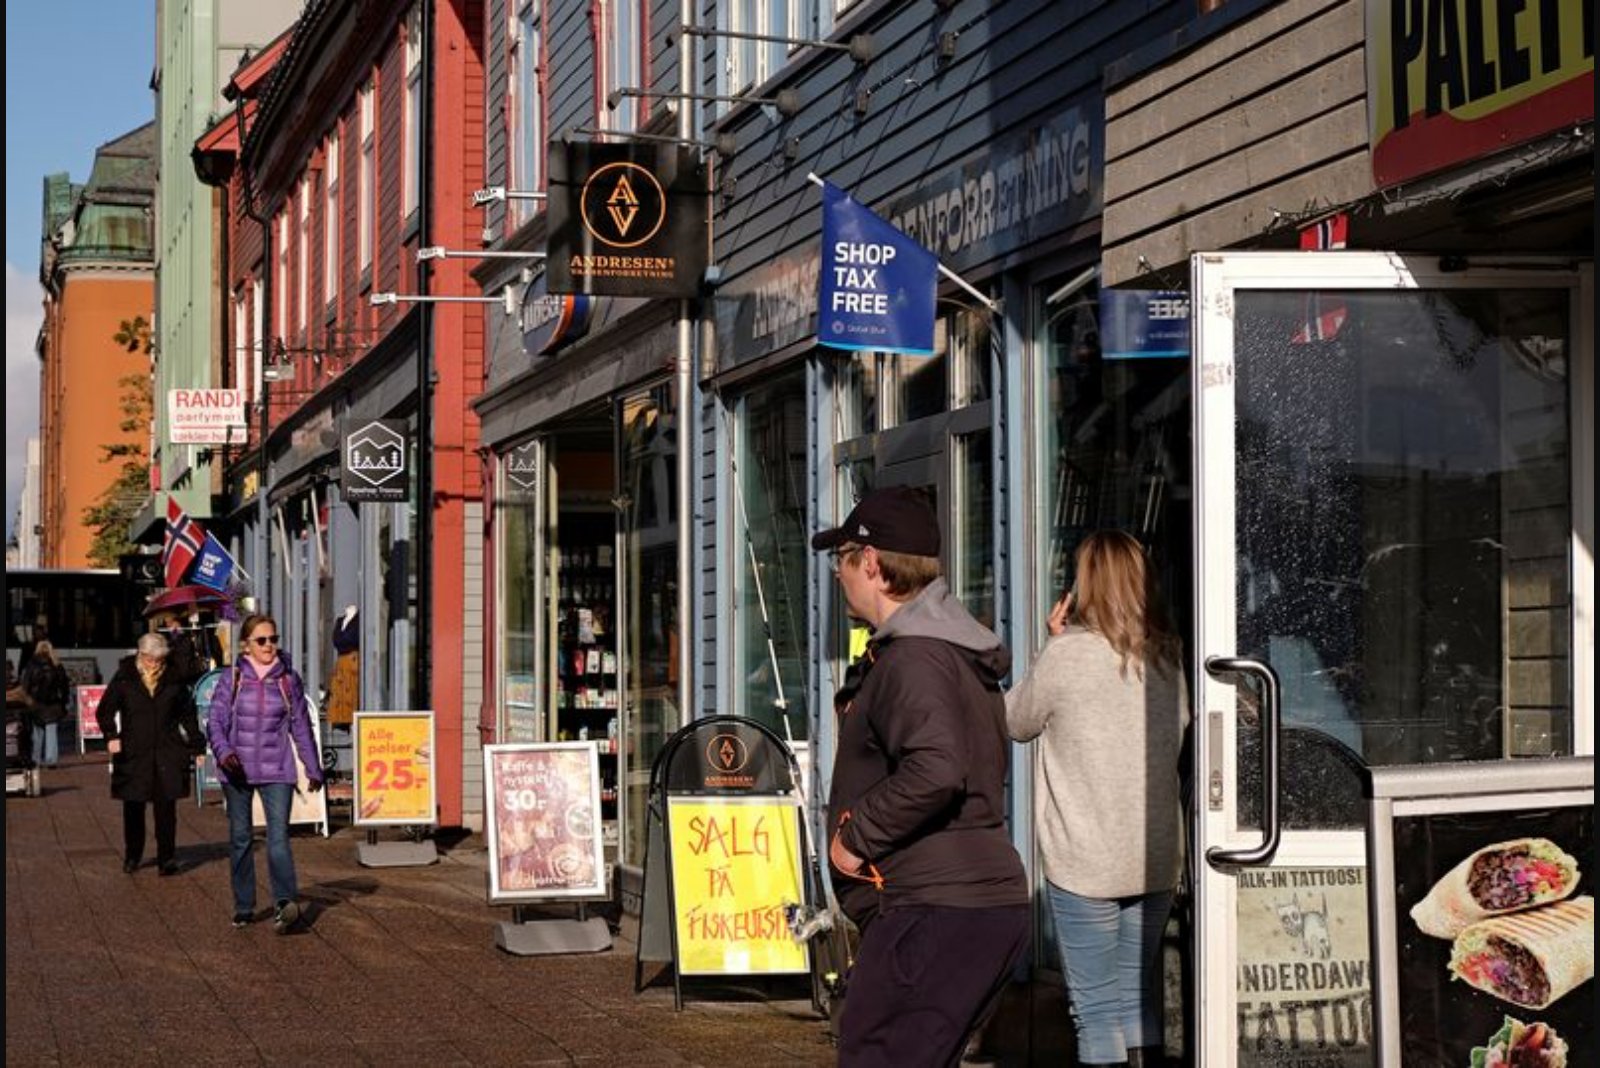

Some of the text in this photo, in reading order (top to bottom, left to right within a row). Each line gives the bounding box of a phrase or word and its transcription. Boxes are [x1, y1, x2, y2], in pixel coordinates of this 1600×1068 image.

[834, 241, 897, 266] SHOP
[833, 266, 877, 289] TAX
[831, 291, 889, 315] FREE
[176, 390, 241, 408] RANDI
[368, 728, 394, 740] Alle
[688, 815, 771, 863] SALG
[1237, 868, 1363, 889] ALK-IN TATTOOS!
[1237, 960, 1371, 993] NDERDAW
